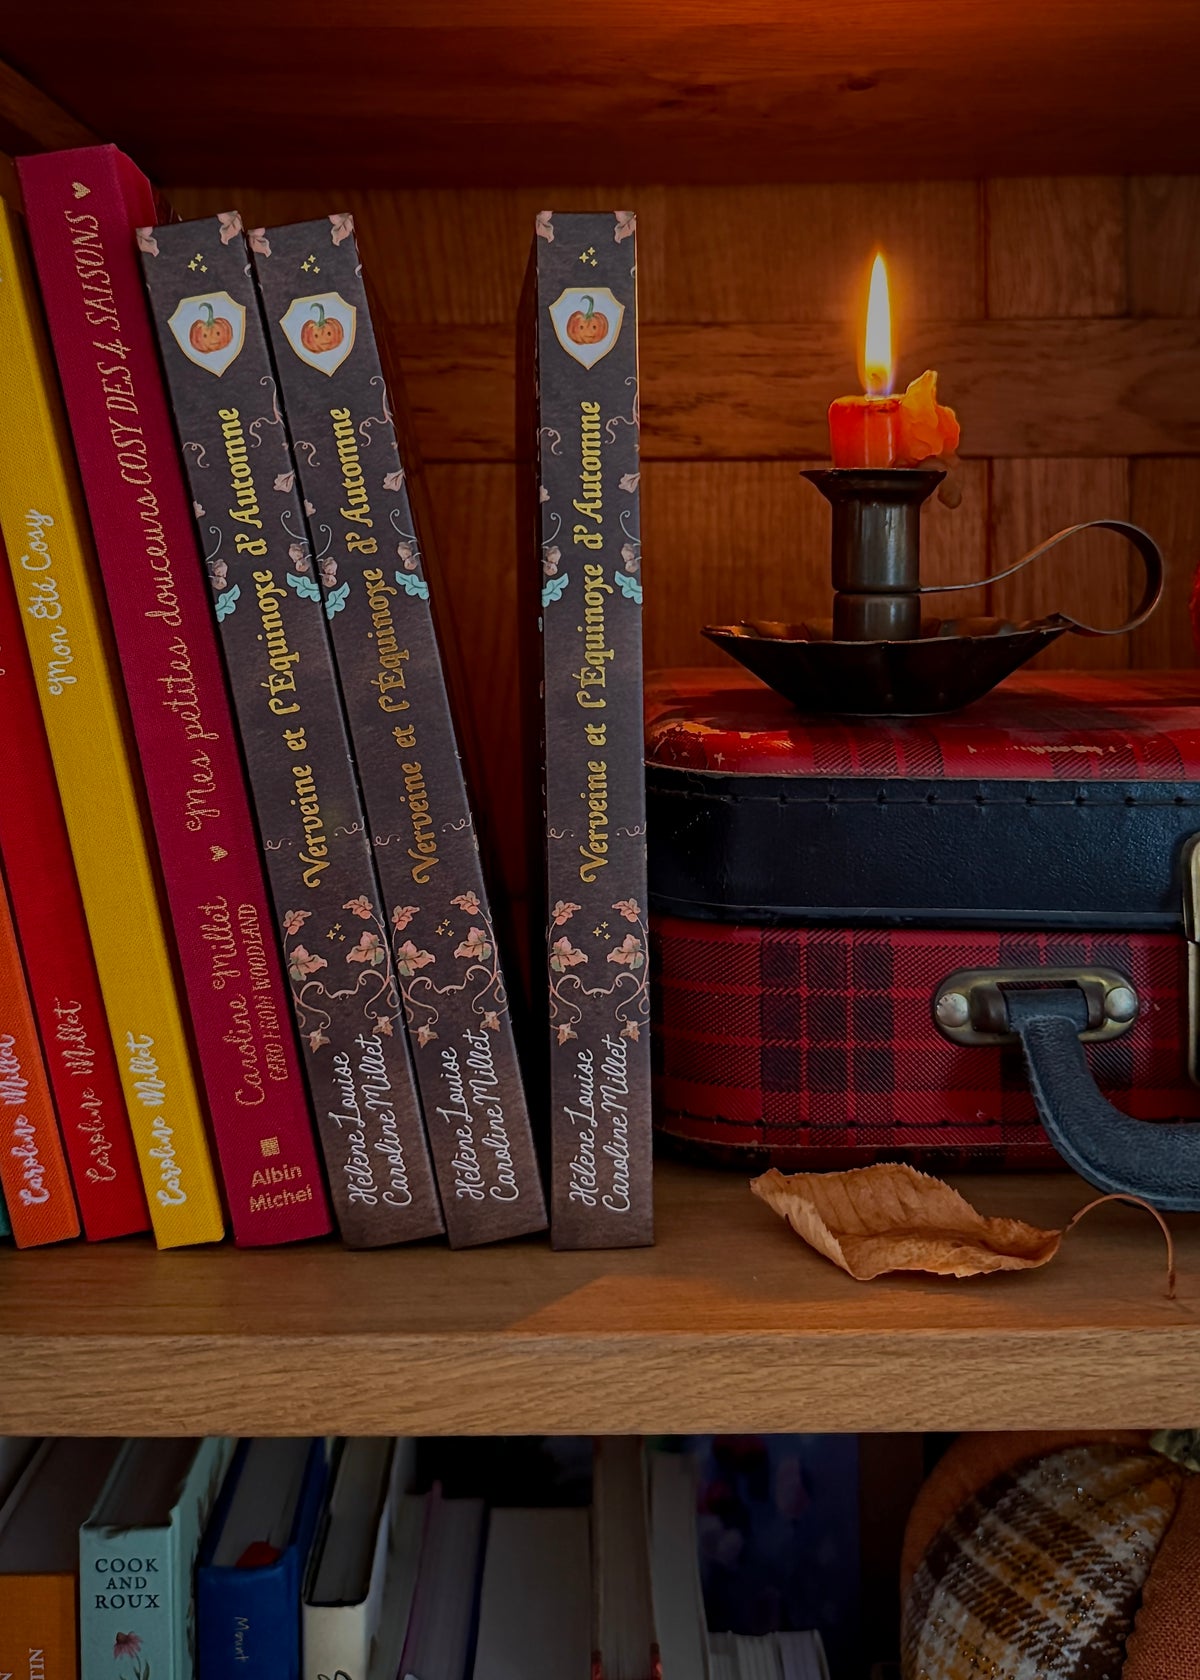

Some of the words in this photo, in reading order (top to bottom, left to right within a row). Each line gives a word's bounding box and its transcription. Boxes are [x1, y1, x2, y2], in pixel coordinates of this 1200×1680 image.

[64, 209, 121, 332] SAISONS
[93, 338, 132, 359] 4
[97, 361, 139, 415] DES
[108, 416, 153, 485] COSY
[21, 508, 55, 572] Cosy
[136, 487, 183, 627] douceurs
[48, 625, 78, 695] Mon
[157, 636, 219, 740] petites
[282, 726, 308, 751] et
[392, 723, 417, 748] et
[584, 722, 607, 746] et
[290, 764, 330, 888] Verveine
[399, 761, 440, 884] Verveine
[578, 760, 609, 883] Verveine
[197, 895, 241, 990] Millet
[238, 903, 271, 991] WOODLAND
[53, 996, 96, 1076] Millet
[222, 992, 265, 1107] Caroline
[255, 995, 281, 1039] FROM
[125, 1030, 166, 1107] Millet
[264, 1043, 288, 1082] CARO
[328, 1051, 365, 1128] Louise
[354, 1033, 394, 1112] Millet
[436, 1046, 473, 1124] Louise
[462, 1028, 501, 1106] Millet
[563, 1048, 598, 1127] Louise
[600, 1033, 629, 1114] Millet
[11, 1114, 50, 1206] Caroline
[76, 1086, 117, 1184] Caroline
[149, 1115, 187, 1207] Caroline
[344, 1126, 378, 1206] Hélène
[374, 1109, 413, 1207] Caroline
[451, 1124, 485, 1201] Hélène
[481, 1104, 519, 1202] Caroline
[568, 1127, 597, 1207] Hélène
[601, 1112, 631, 1213] Caroline
[249, 1184, 313, 1213] Michel
[251, 1163, 302, 1188] Albin
[95, 1558, 160, 1573] COOK
[95, 1594, 160, 1609] ROUX
[106, 1577, 147, 1590] AND
